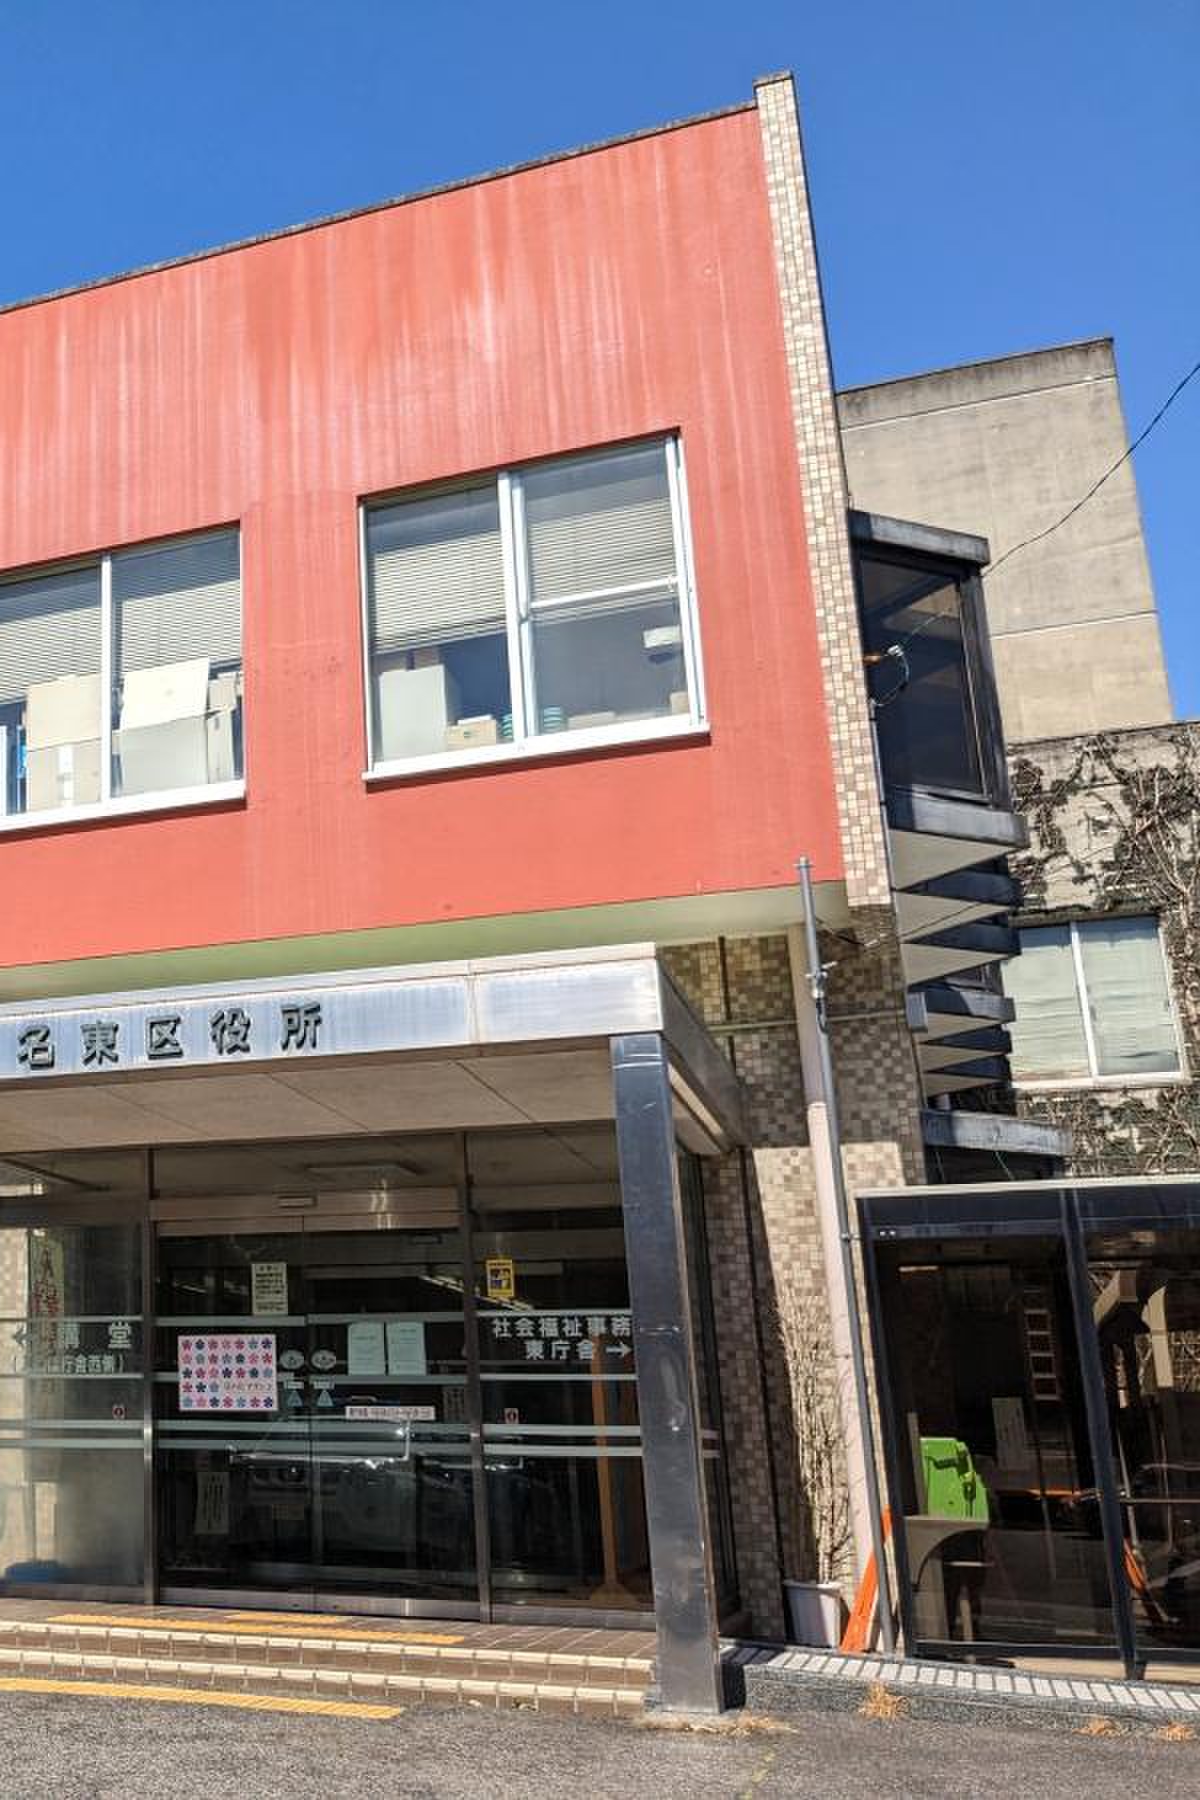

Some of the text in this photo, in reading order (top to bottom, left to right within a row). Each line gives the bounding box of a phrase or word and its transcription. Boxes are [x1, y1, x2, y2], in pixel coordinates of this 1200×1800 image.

[17, 1001, 323, 1069] 名東区役所
